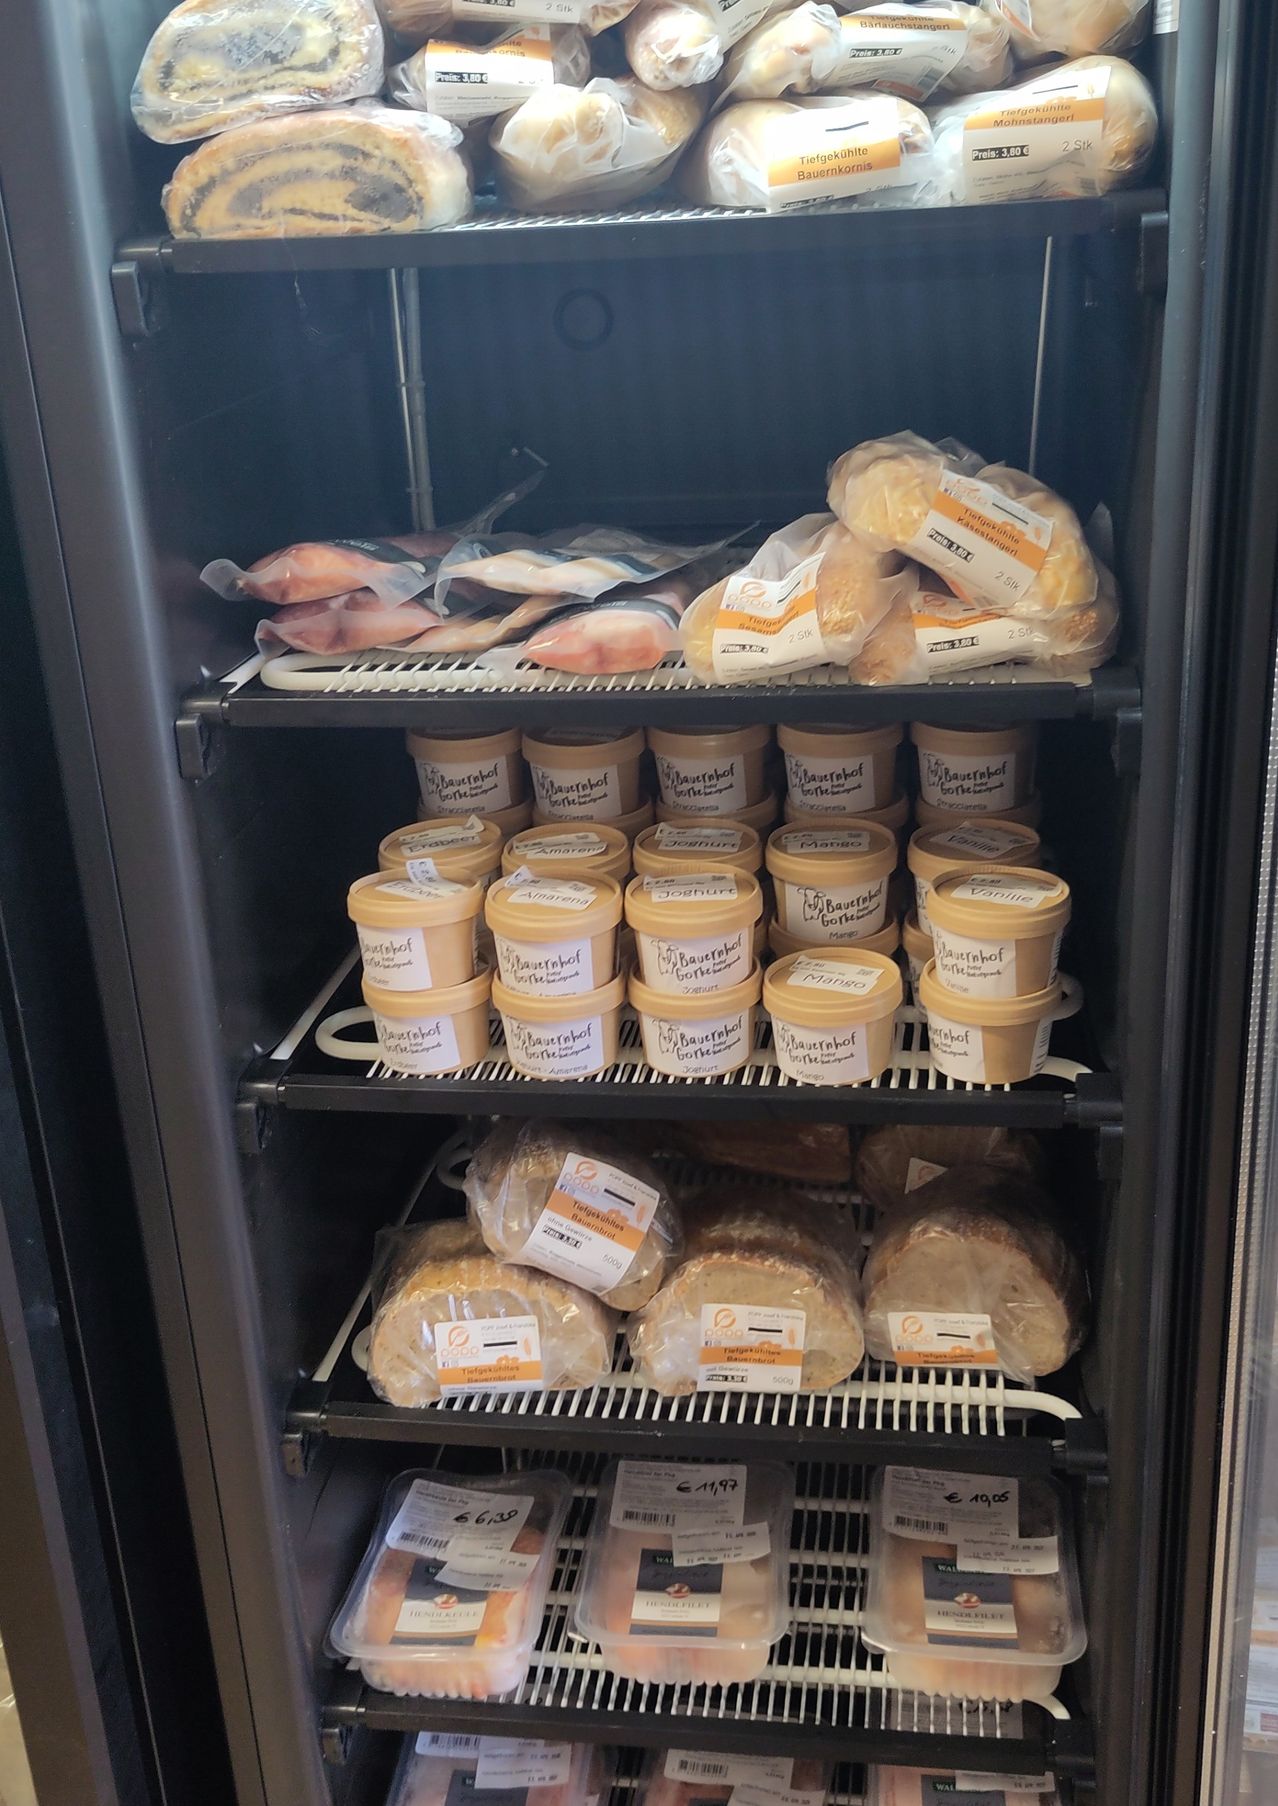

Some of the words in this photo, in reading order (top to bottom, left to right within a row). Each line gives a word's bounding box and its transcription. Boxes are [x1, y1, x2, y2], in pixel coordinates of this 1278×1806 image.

[1001, 104, 1072, 117] Tiefgekühlte
[993, 114, 1074, 127] Mohnstangerl
[972, 150, 1000, 160] Preis:
[1001, 146, 1022, 158] 3,80
[1062, 141, 1070, 152] 2
[1074, 139, 1093, 151] Stk
[800, 147, 869, 166] Tiefgekühlte
[797, 162, 873, 181] Bauernkornis
[994, 571, 1003, 580] 2
[1003, 576, 1021, 592] Stk
[1008, 629, 1015, 640] 2
[927, 643, 952, 653] Preis:
[441, 763, 499, 790] Bauernhof
[675, 763, 735, 785] Bauernhof
[804, 763, 864, 784] Bauernhof
[944, 761, 1008, 782] Bauernhof
[551, 772, 609, 796] Bauernhof
[408, 835, 478, 853] Erdbeer
[535, 845, 604, 855] Amarena
[665, 840, 738, 849] Joghurt
[801, 841, 862, 849] Mango
[948, 835, 1000, 852] Vanille
[520, 891, 589, 905] Amarena
[658, 887, 736, 899] Joghurt
[826, 880, 882, 914] Bauernhof
[969, 887, 1033, 903] Vanille
[828, 930, 858, 940] Mango
[679, 933, 742, 968] Bauernhof
[942, 942, 1004, 964] Bauernhof
[516, 949, 581, 971] Bauernhof
[676, 966, 711, 982] Gorke
[803, 973, 867, 989] Mango
[527, 1023, 592, 1047] Bauernhof
[680, 1015, 743, 1048] Bauernhof
[791, 1031, 856, 1051] Bauernhof
[677, 1048, 711, 1061] Gorke
[573, 1201, 625, 1232] Tiefgekühltes
[602, 1254, 624, 1271] 500g
[724, 1347, 781, 1356] Tiefgekühltes
[462, 1364, 520, 1376] Tiefgekühltes
[772, 1376, 794, 1386] 500g
[676, 1481, 692, 1493] €
[695, 1479, 739, 1496] 11,97
[944, 1492, 962, 1504] €
